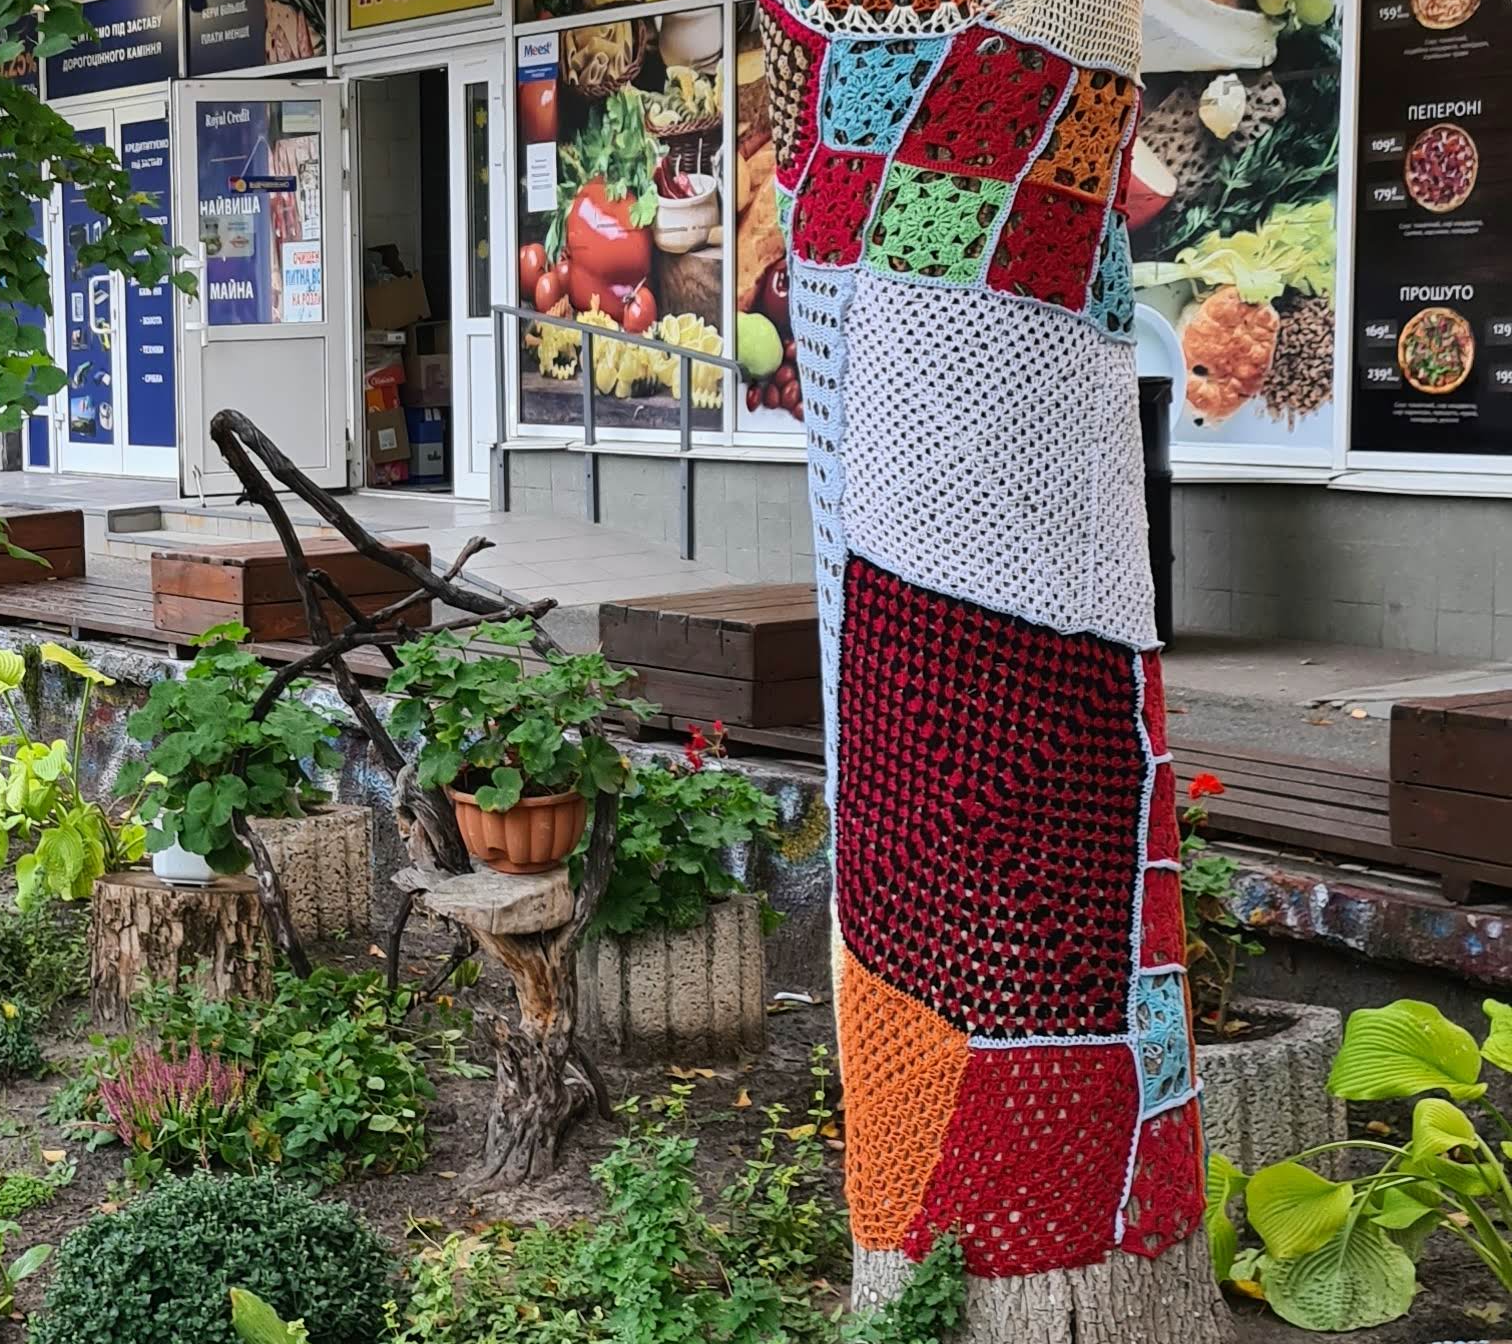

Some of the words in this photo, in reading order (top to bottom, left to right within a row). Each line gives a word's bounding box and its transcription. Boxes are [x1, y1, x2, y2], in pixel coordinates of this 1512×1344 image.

[112, 22, 126, 37] ПІД
[62, 48, 125, 72] ДОРОГОЦІННОГО
[126, 42, 162, 61] КАМІННЯ
[227, 108, 250, 124] Credit
[1408, 100, 1482, 121] ПЕПЕРОНІ
[209, 278, 254, 300] МАЙНА
[1399, 285, 1474, 301] ПРОШУТО
